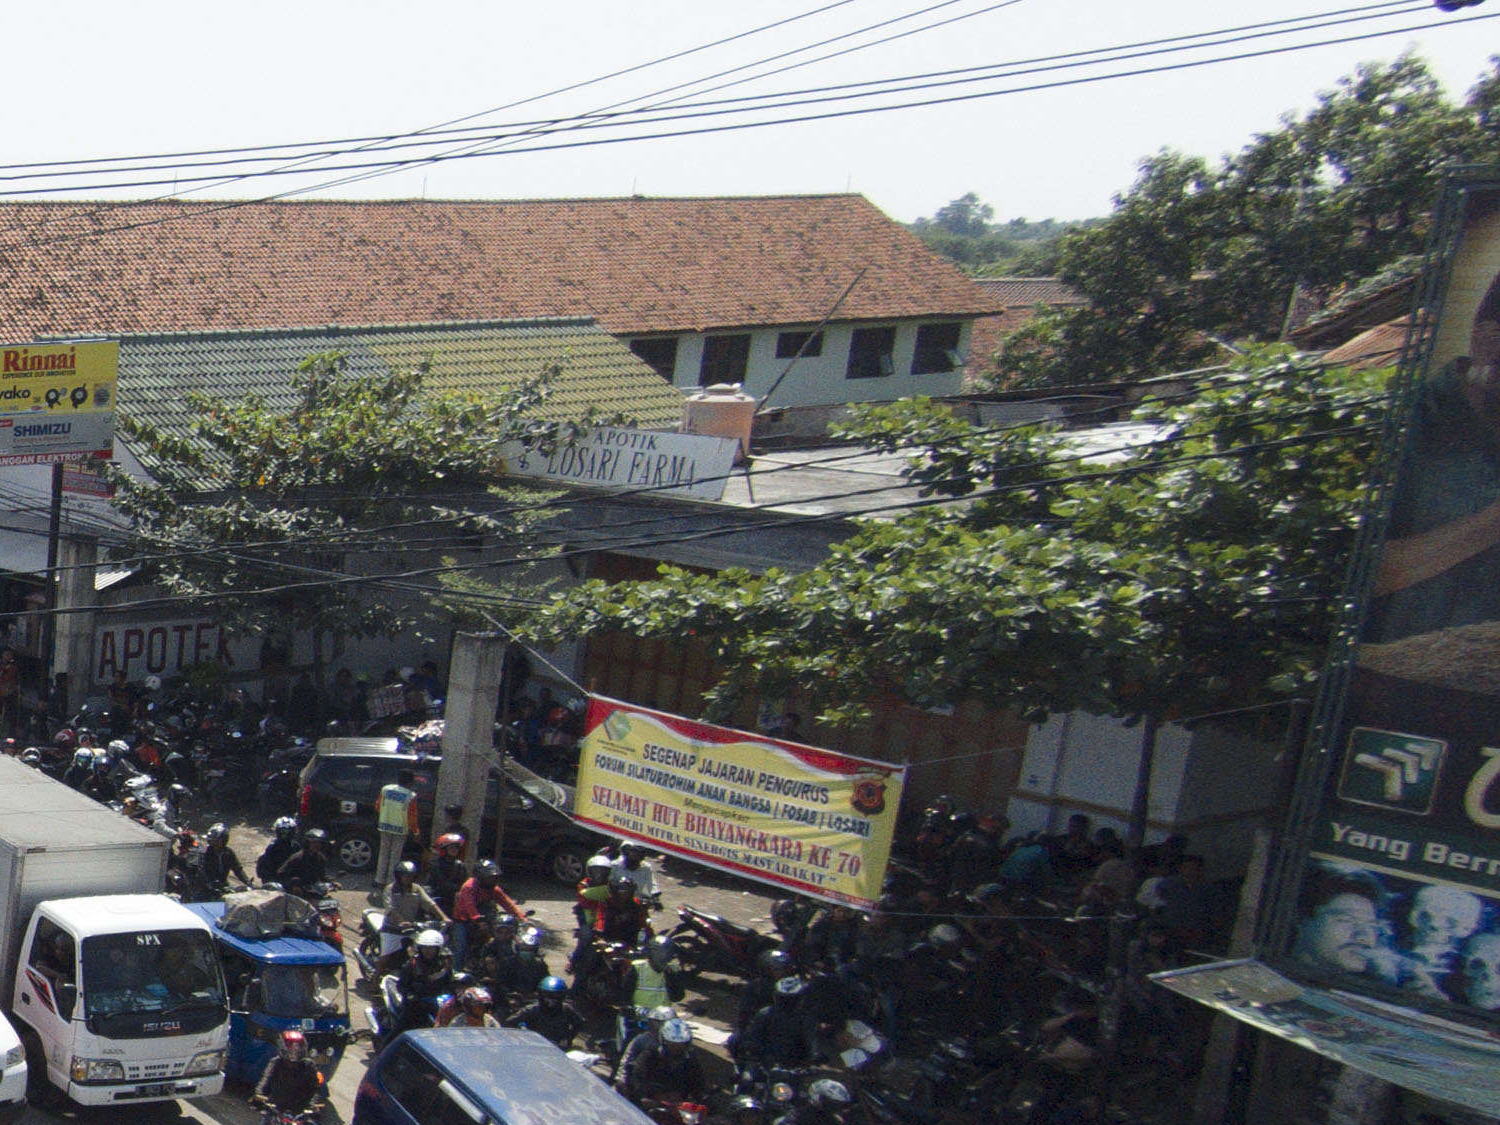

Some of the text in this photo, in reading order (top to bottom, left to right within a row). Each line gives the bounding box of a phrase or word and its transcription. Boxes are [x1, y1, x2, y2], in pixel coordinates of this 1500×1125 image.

[3, 346, 76, 372] Rinnai
[13, 423, 72, 438] SHIMIZU
[593, 430, 660, 450] APOTIK
[546, 447, 695, 490] LOSARI FARMA
[642, 743, 696, 771] SEGENAP
[697, 758, 755, 787] JAJARAN
[756, 772, 829, 805] PENGURUS
[595, 754, 625, 776] FORUM
[627, 764, 696, 796] SILATURROHIM
[697, 783, 727, 804] ANAK
[728, 790, 772, 814] BANGSA
[827, 815, 871, 838] LOSARI
[684, 798, 750, 823] Mengucapkan
[591, 785, 861, 877] SELAMAT HUT BHAYANGKARA KE 70
[1331, 822, 1412, 861] Yang
[613, 815, 643, 832] POLRI
[647, 824, 680, 843] MITRA
[683, 836, 739, 861] SINERGIS
[743, 852, 825, 885] MASYARAKAT
[136, 934, 162, 945] SPX
[143, 1021, 181, 1032] ISUZU
